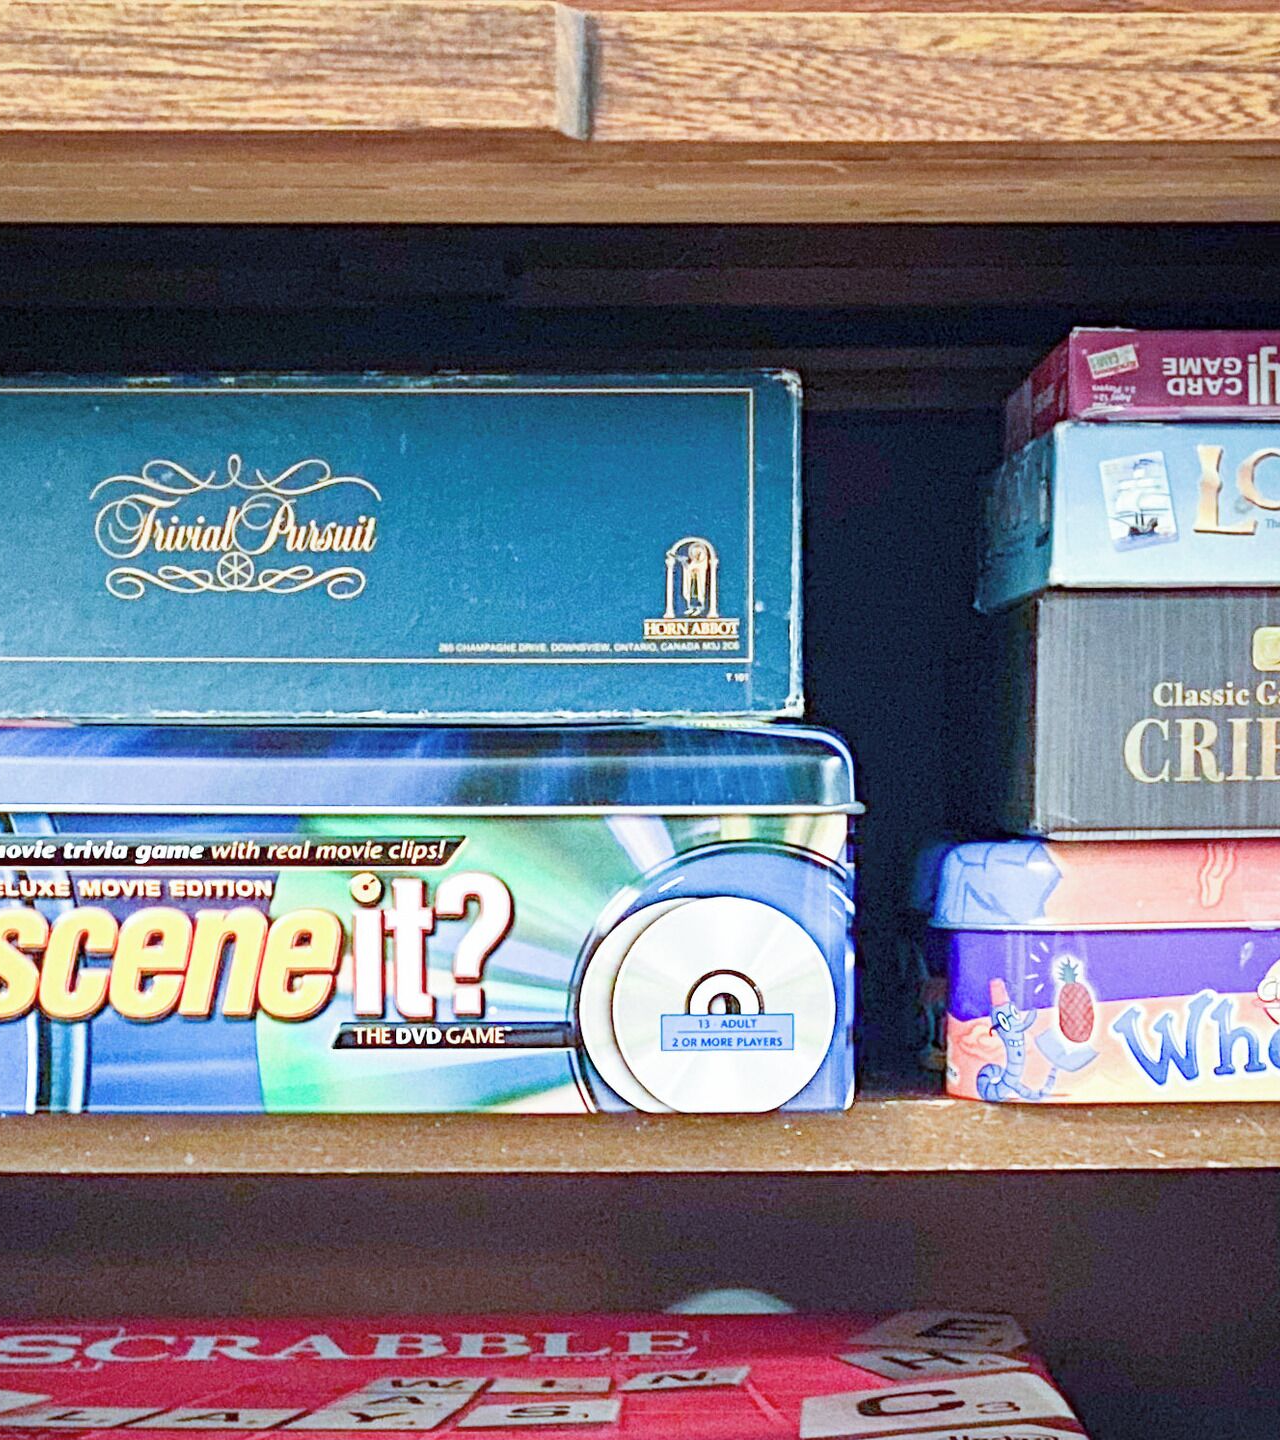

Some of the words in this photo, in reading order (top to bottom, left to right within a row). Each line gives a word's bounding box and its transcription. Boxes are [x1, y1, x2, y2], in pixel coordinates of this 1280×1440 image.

[1162, 356, 1243, 376] GAME
[1166, 377, 1243, 396] CARD
[95, 493, 241, 559] Trivial
[232, 492, 379, 556] Pursuit
[643, 622, 689, 636] HORN
[690, 622, 740, 636] ABBOT
[1152, 680, 1250, 707] Classic
[63, 840, 128, 860] trivia
[135, 843, 204, 865] game
[210, 840, 261, 860] with
[266, 840, 310, 860] real
[316, 841, 385, 860] movie
[388, 839, 446, 864] clips!
[78, 879, 161, 898] MOVIE
[170, 879, 274, 898] EDITION
[698, 1018, 710, 1029] 13
[720, 1018, 757, 1029] ADULT
[353, 1026, 392, 1044] THE
[395, 1026, 443, 1045] DVD
[445, 1026, 506, 1045] GAME
[672, 1038, 679, 1048] 2
[681, 1037, 697, 1047] OR
[700, 1037, 733, 1047] MORE
[736, 1036, 783, 1047] PLAYERS
